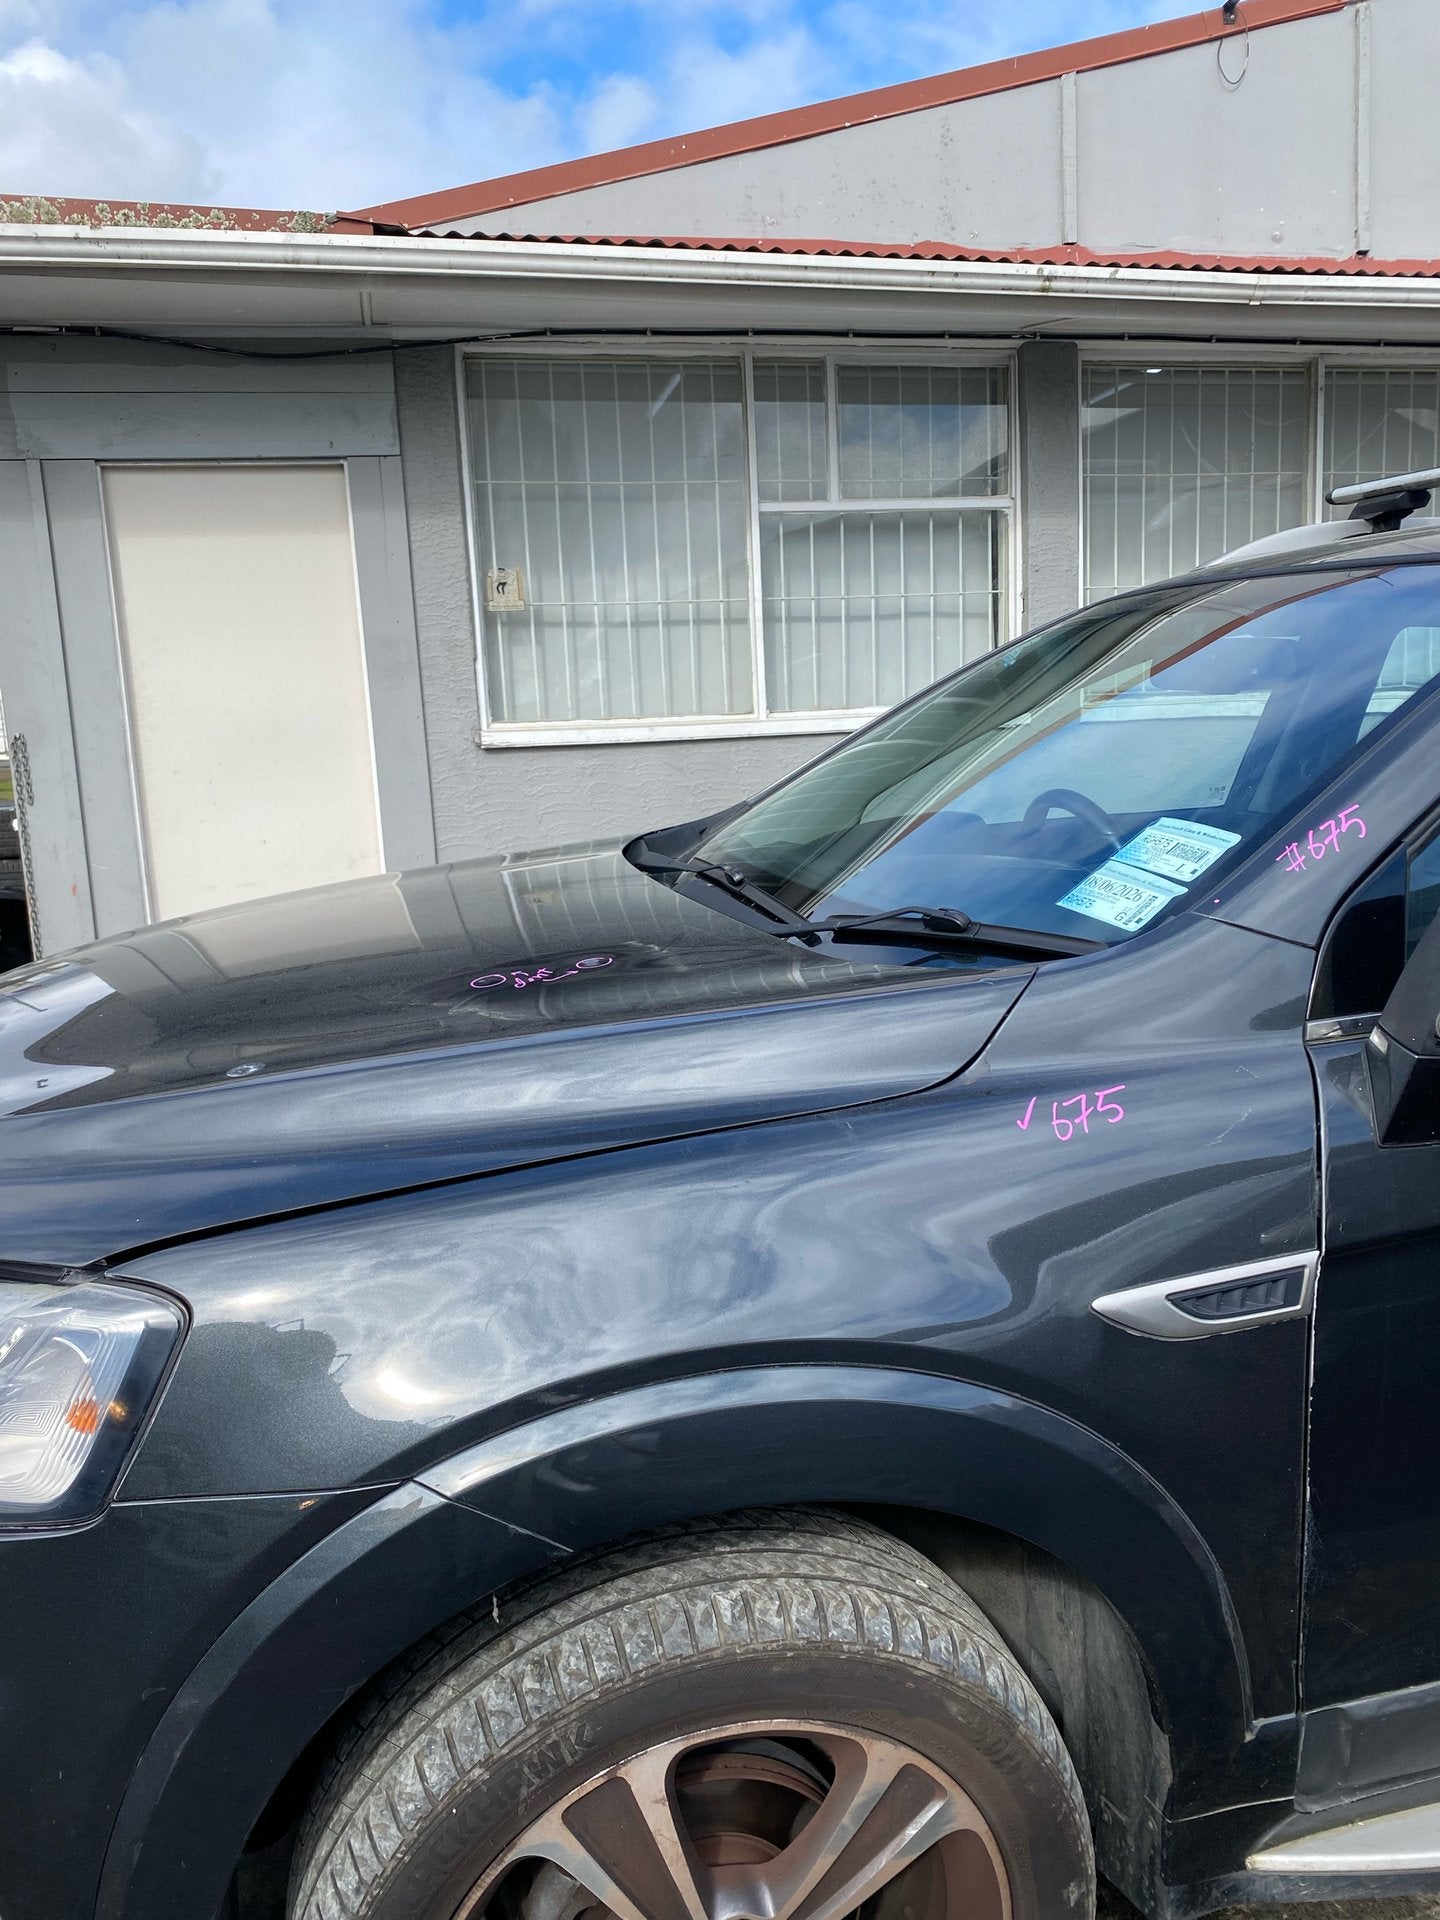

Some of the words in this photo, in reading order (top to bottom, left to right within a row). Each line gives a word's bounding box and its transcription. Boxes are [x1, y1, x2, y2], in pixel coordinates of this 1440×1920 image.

[1275, 803, 1367, 872] #675
[1083, 875, 1147, 902] 08/06/2026
[1052, 1084, 1126, 1141] 675
